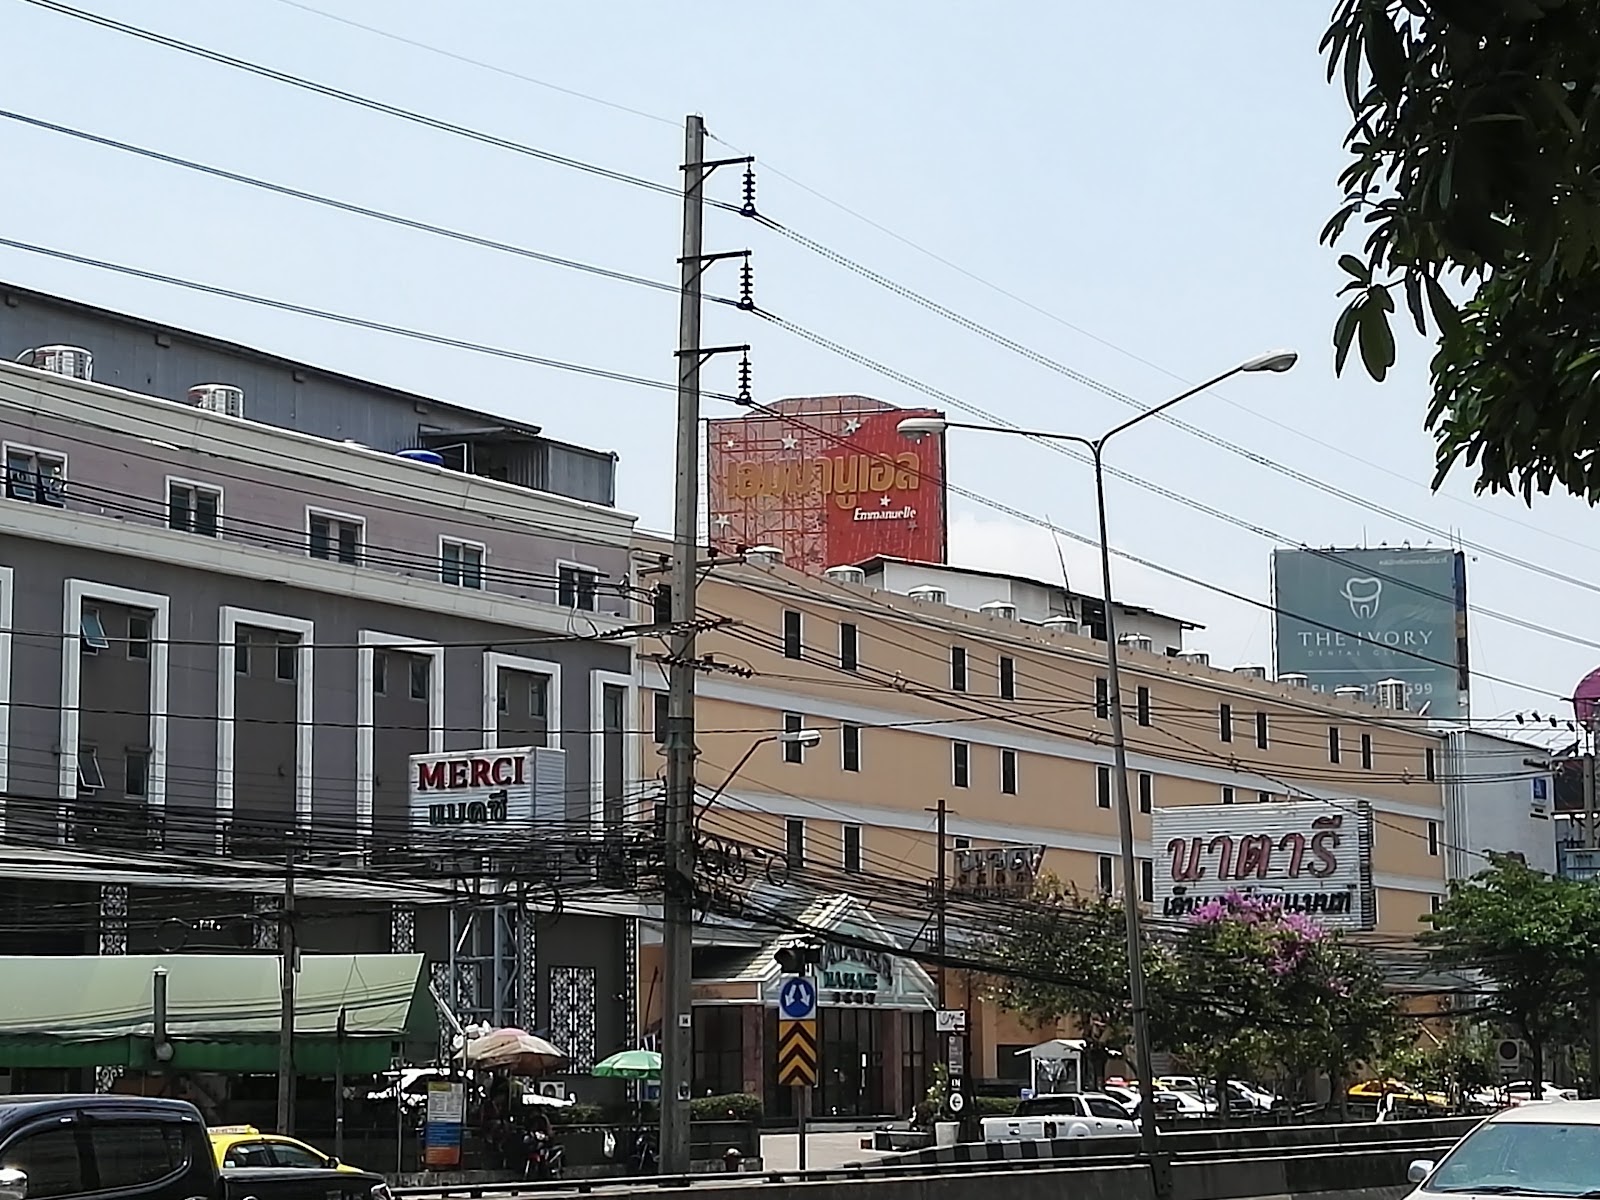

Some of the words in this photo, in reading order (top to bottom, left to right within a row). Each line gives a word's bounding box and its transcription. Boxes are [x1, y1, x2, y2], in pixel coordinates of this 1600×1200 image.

[854, 506, 916, 520] Emmanuelle
[1298, 631, 1346, 647] THE
[1358, 630, 1433, 646] IVORY
[417, 756, 525, 791] MERCI
[1167, 814, 1343, 883] นาตารี
